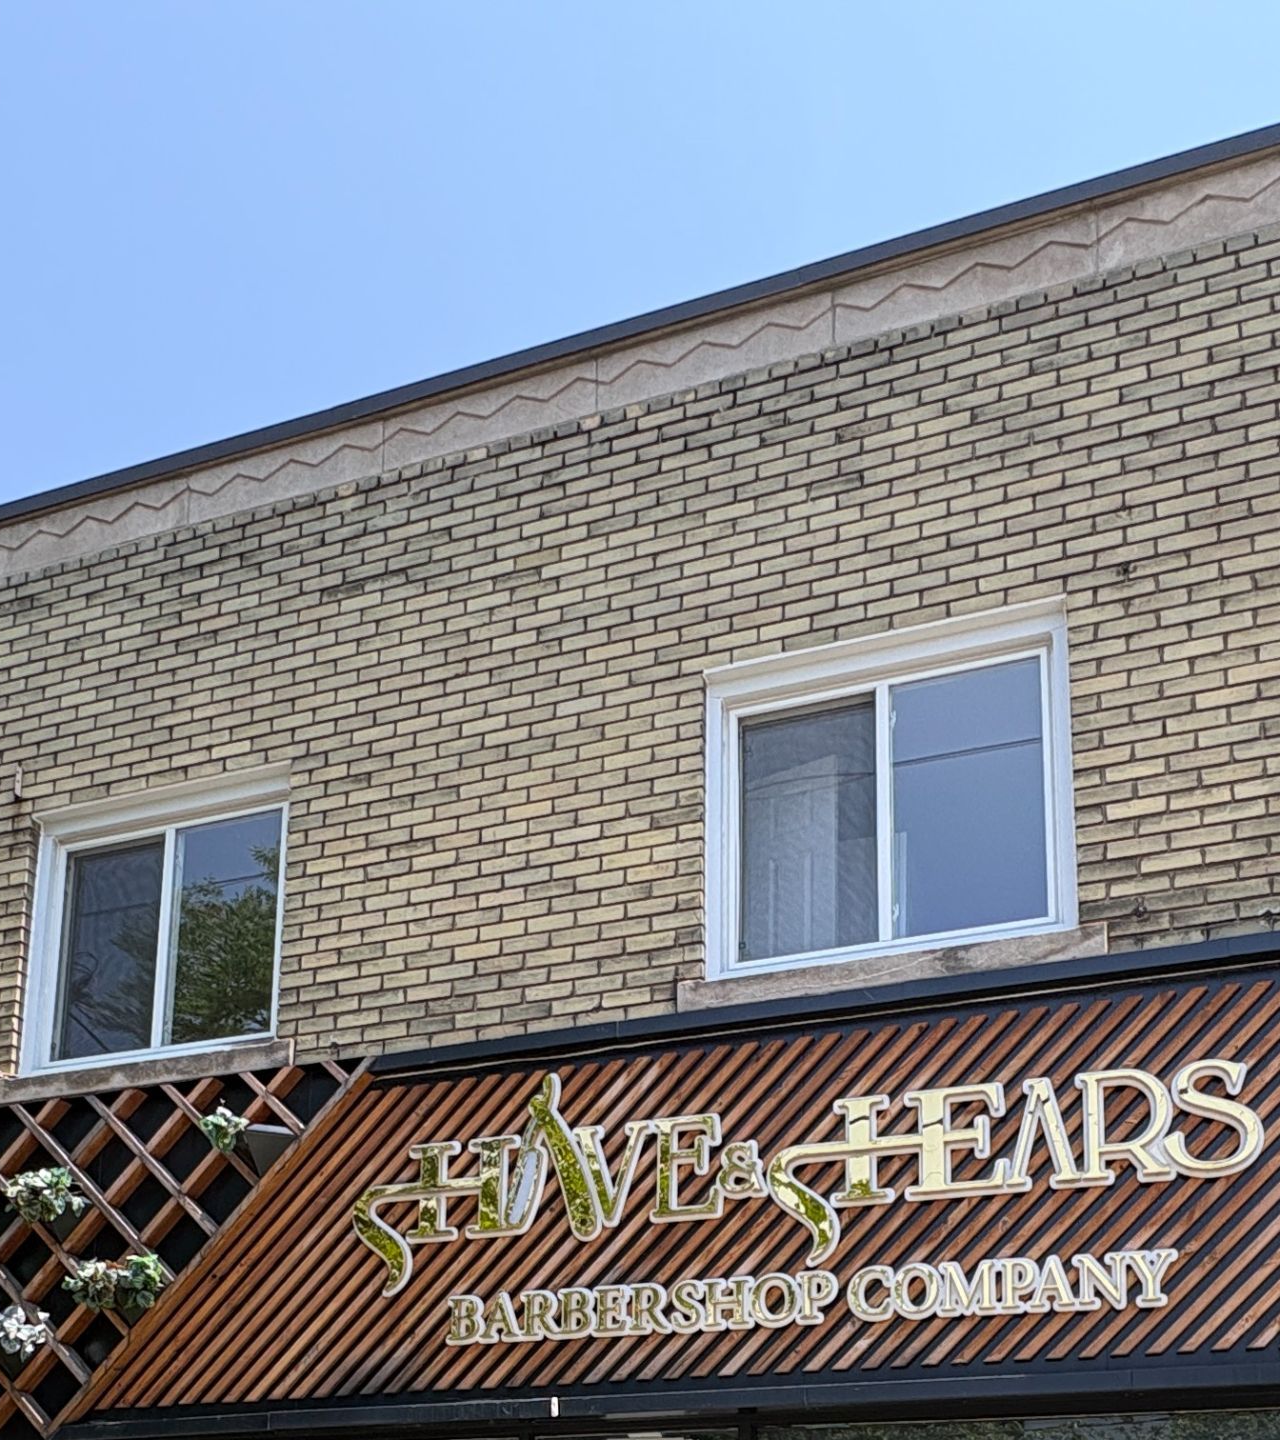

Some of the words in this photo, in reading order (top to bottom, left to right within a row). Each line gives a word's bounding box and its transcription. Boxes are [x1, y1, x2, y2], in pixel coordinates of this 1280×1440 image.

[353, 1072, 723, 1297] SHAVE
[718, 1139, 768, 1200] &
[767, 1059, 1265, 1267] SHEARS
[446, 1271, 838, 1346] BARBERSHOP
[847, 1249, 1178, 1322] COMPANY
